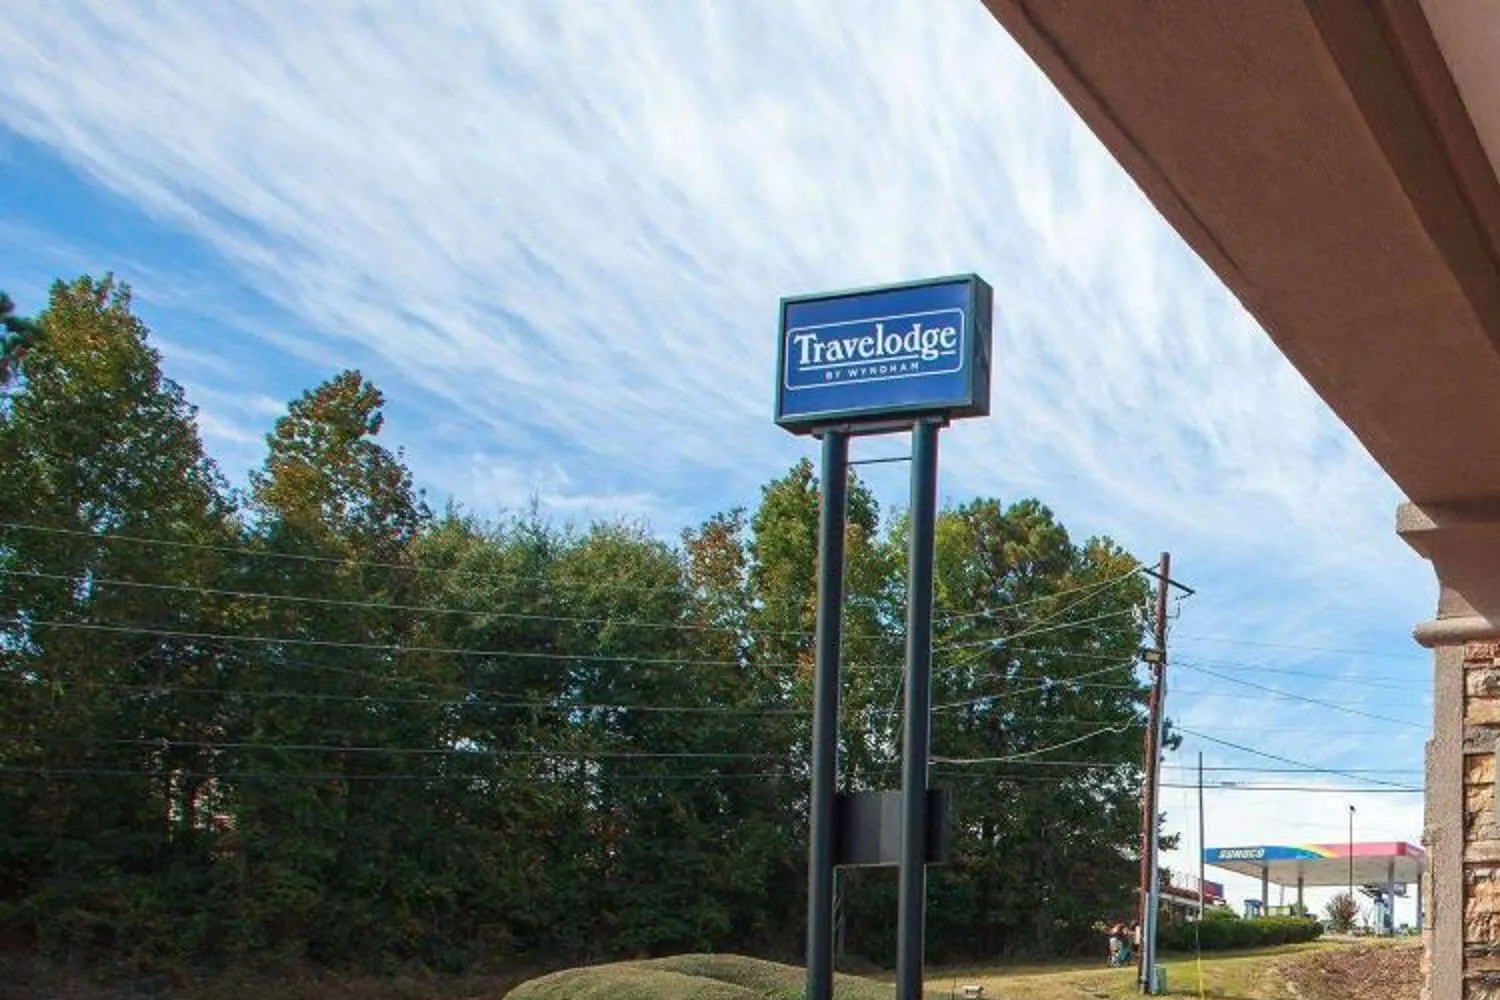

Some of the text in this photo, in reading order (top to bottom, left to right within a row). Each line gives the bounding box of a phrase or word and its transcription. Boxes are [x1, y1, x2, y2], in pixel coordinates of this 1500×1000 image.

[793, 323, 957, 364] Travelodge
[825, 362, 920, 380] BY WYNDHAM
